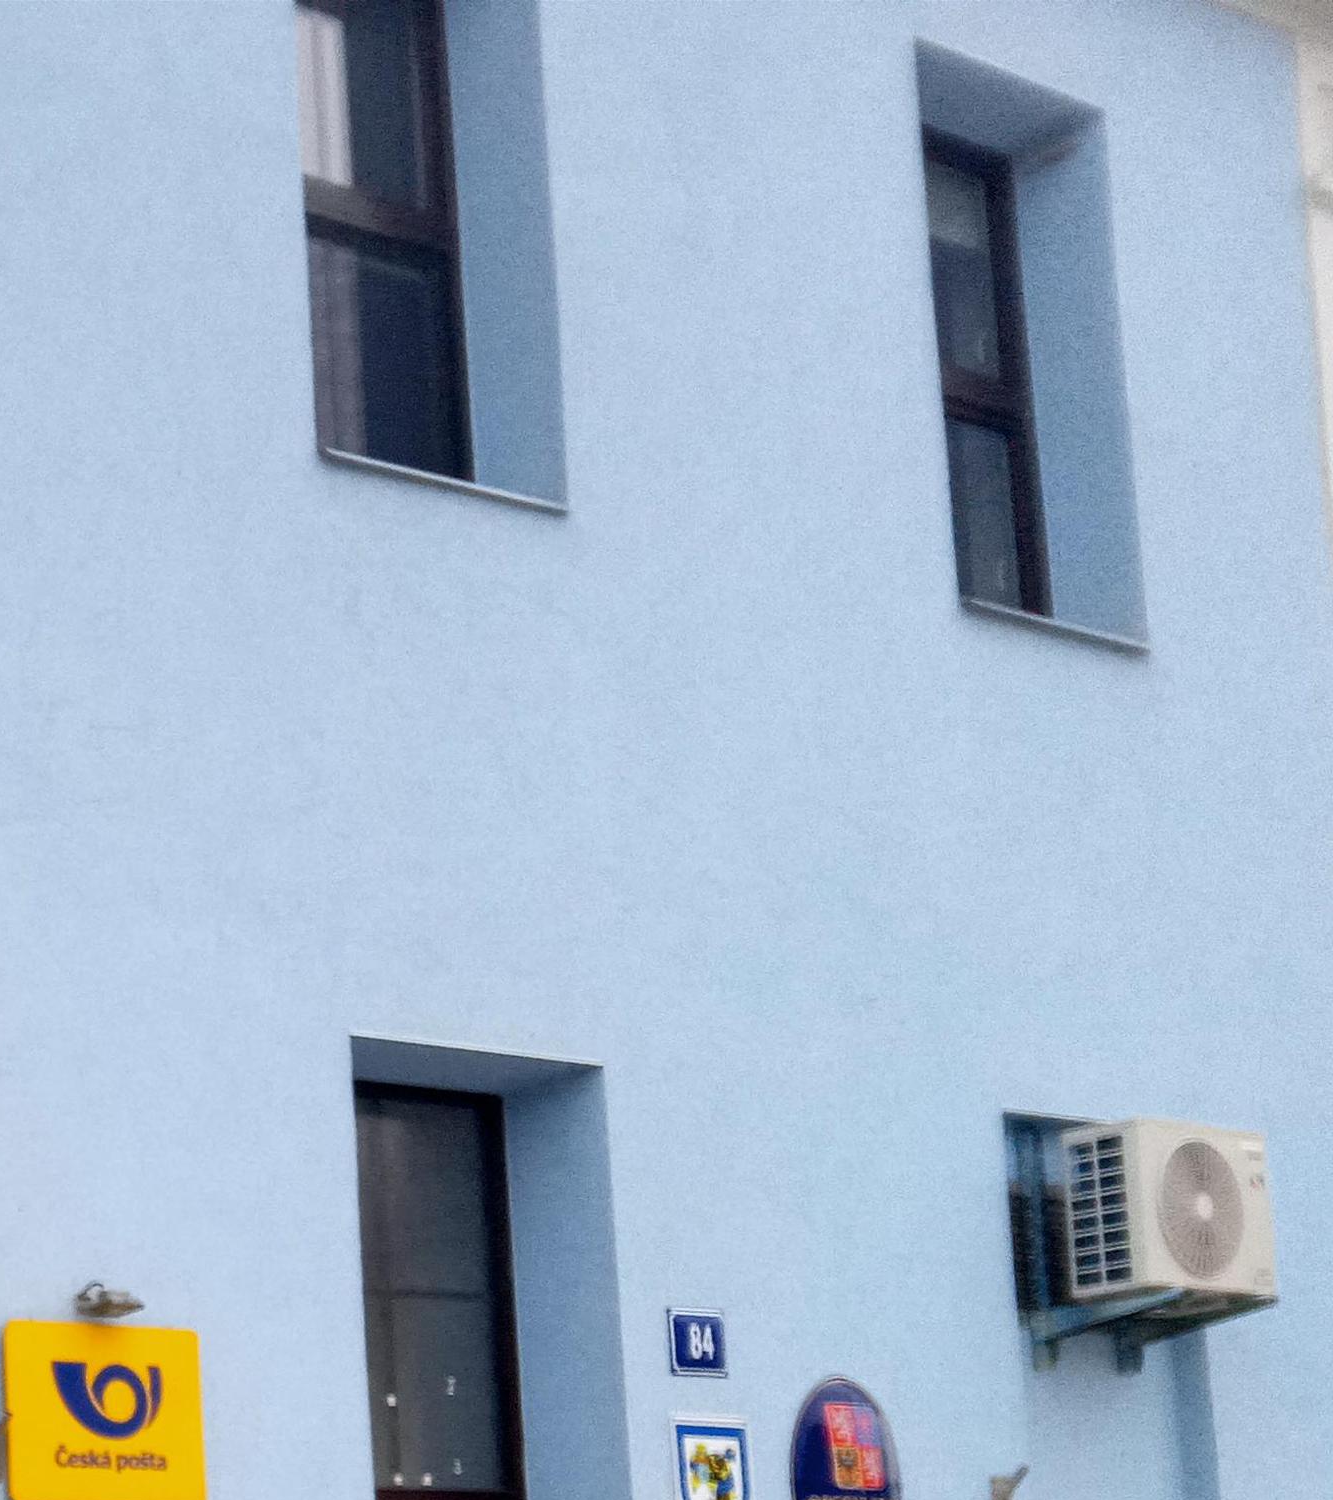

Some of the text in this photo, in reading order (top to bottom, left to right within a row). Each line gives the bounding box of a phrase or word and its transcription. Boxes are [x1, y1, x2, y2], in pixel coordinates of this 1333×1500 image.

[689, 1321, 715, 1362] 84
[54, 1445, 167, 1473] Česká pošta
